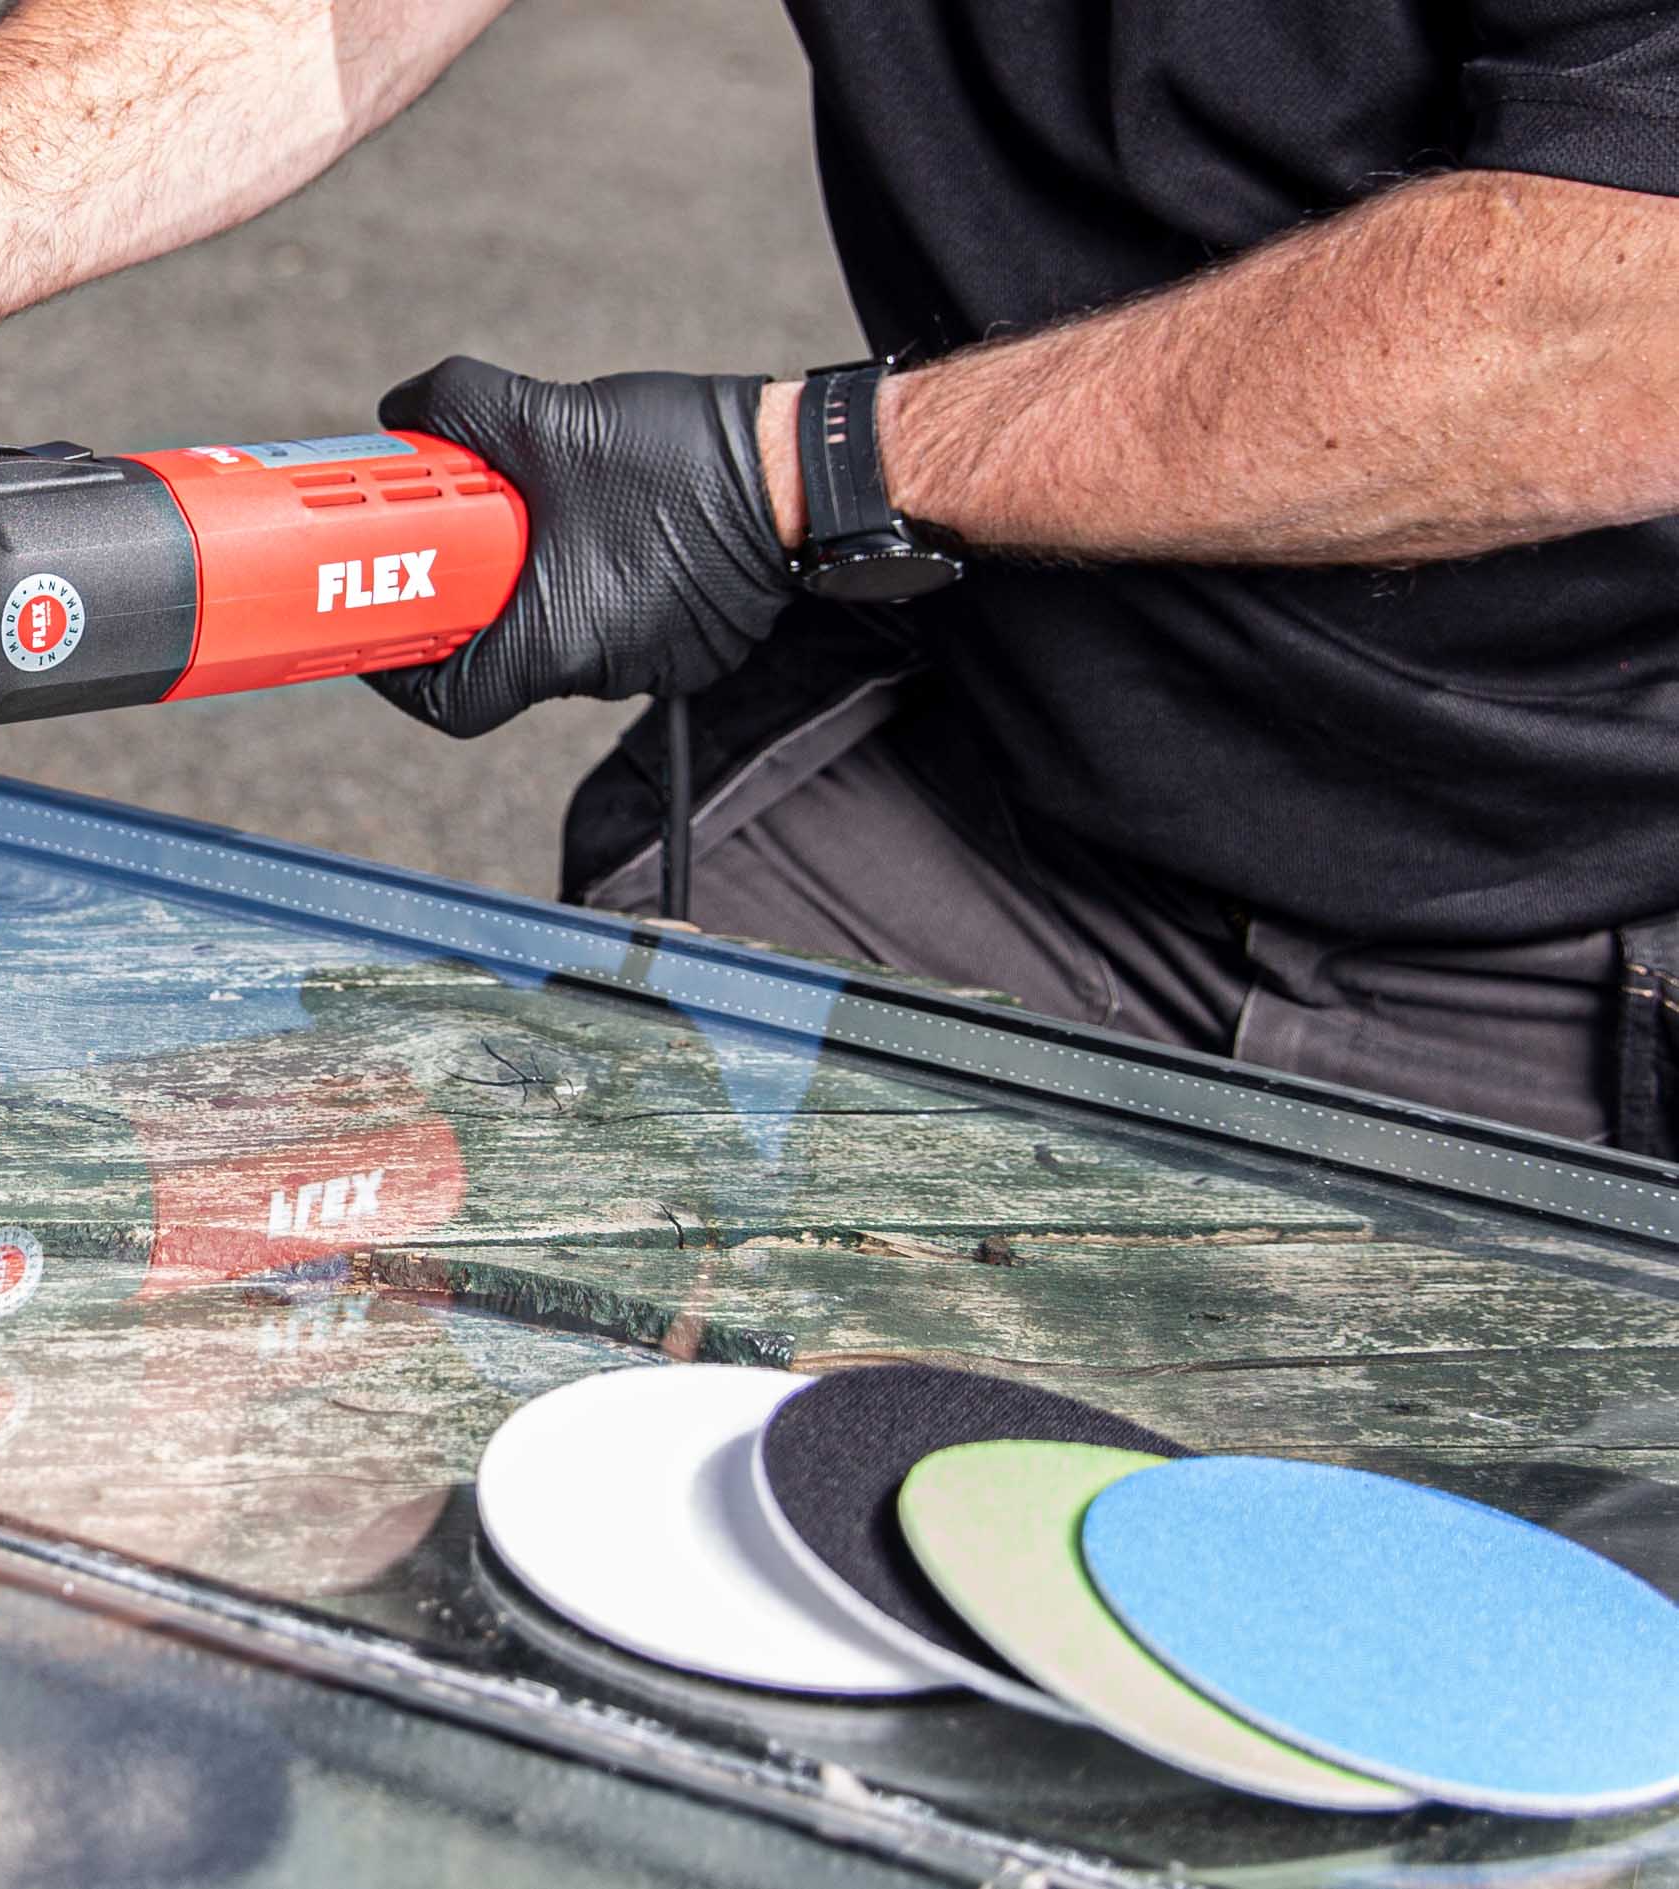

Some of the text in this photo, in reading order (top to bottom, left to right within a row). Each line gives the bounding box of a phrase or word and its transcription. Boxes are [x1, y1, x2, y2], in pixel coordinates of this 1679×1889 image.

[316, 549, 437, 613] FLEX
[6, 580, 80, 666] MADE IN GERMANY
[32, 602, 46, 649] FLEX
